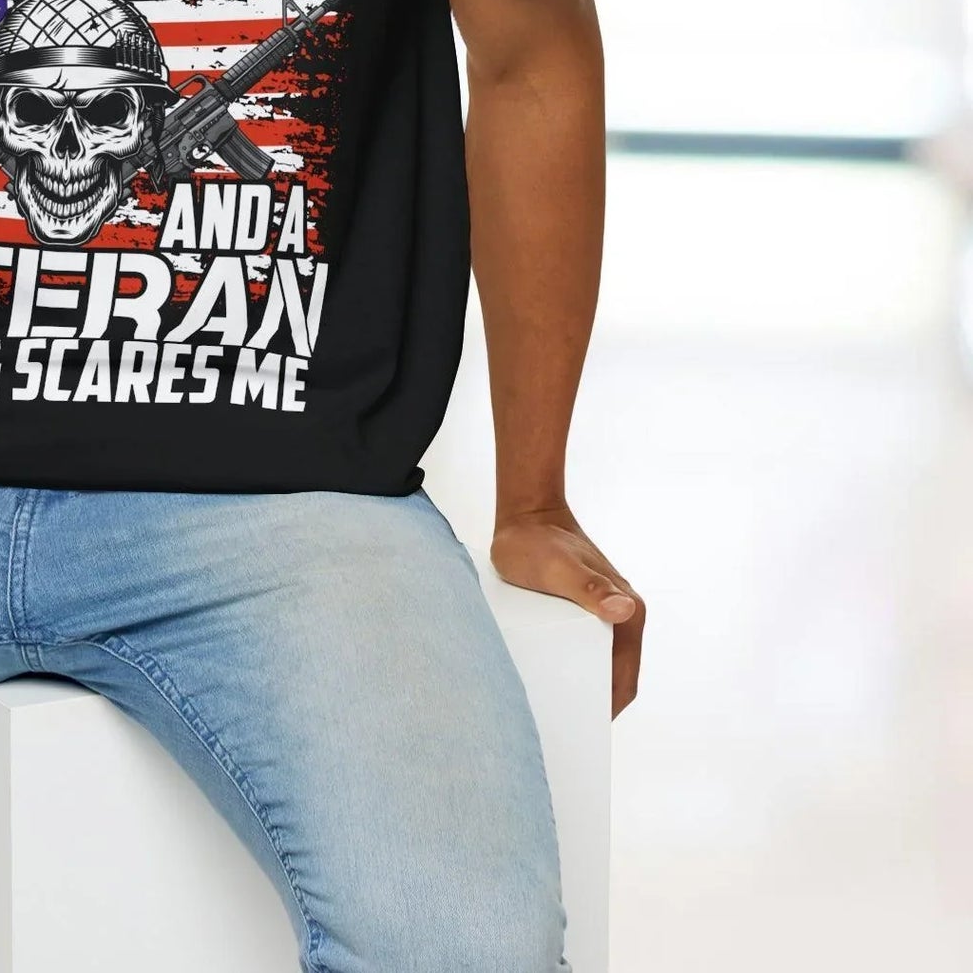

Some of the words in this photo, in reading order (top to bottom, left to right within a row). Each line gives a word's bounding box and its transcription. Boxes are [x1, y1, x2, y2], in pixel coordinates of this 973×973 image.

[161, 183, 271, 252] AND
[281, 185, 309, 253] A
[11, 338, 222, 403] SCARES
[229, 347, 309, 412] ME
